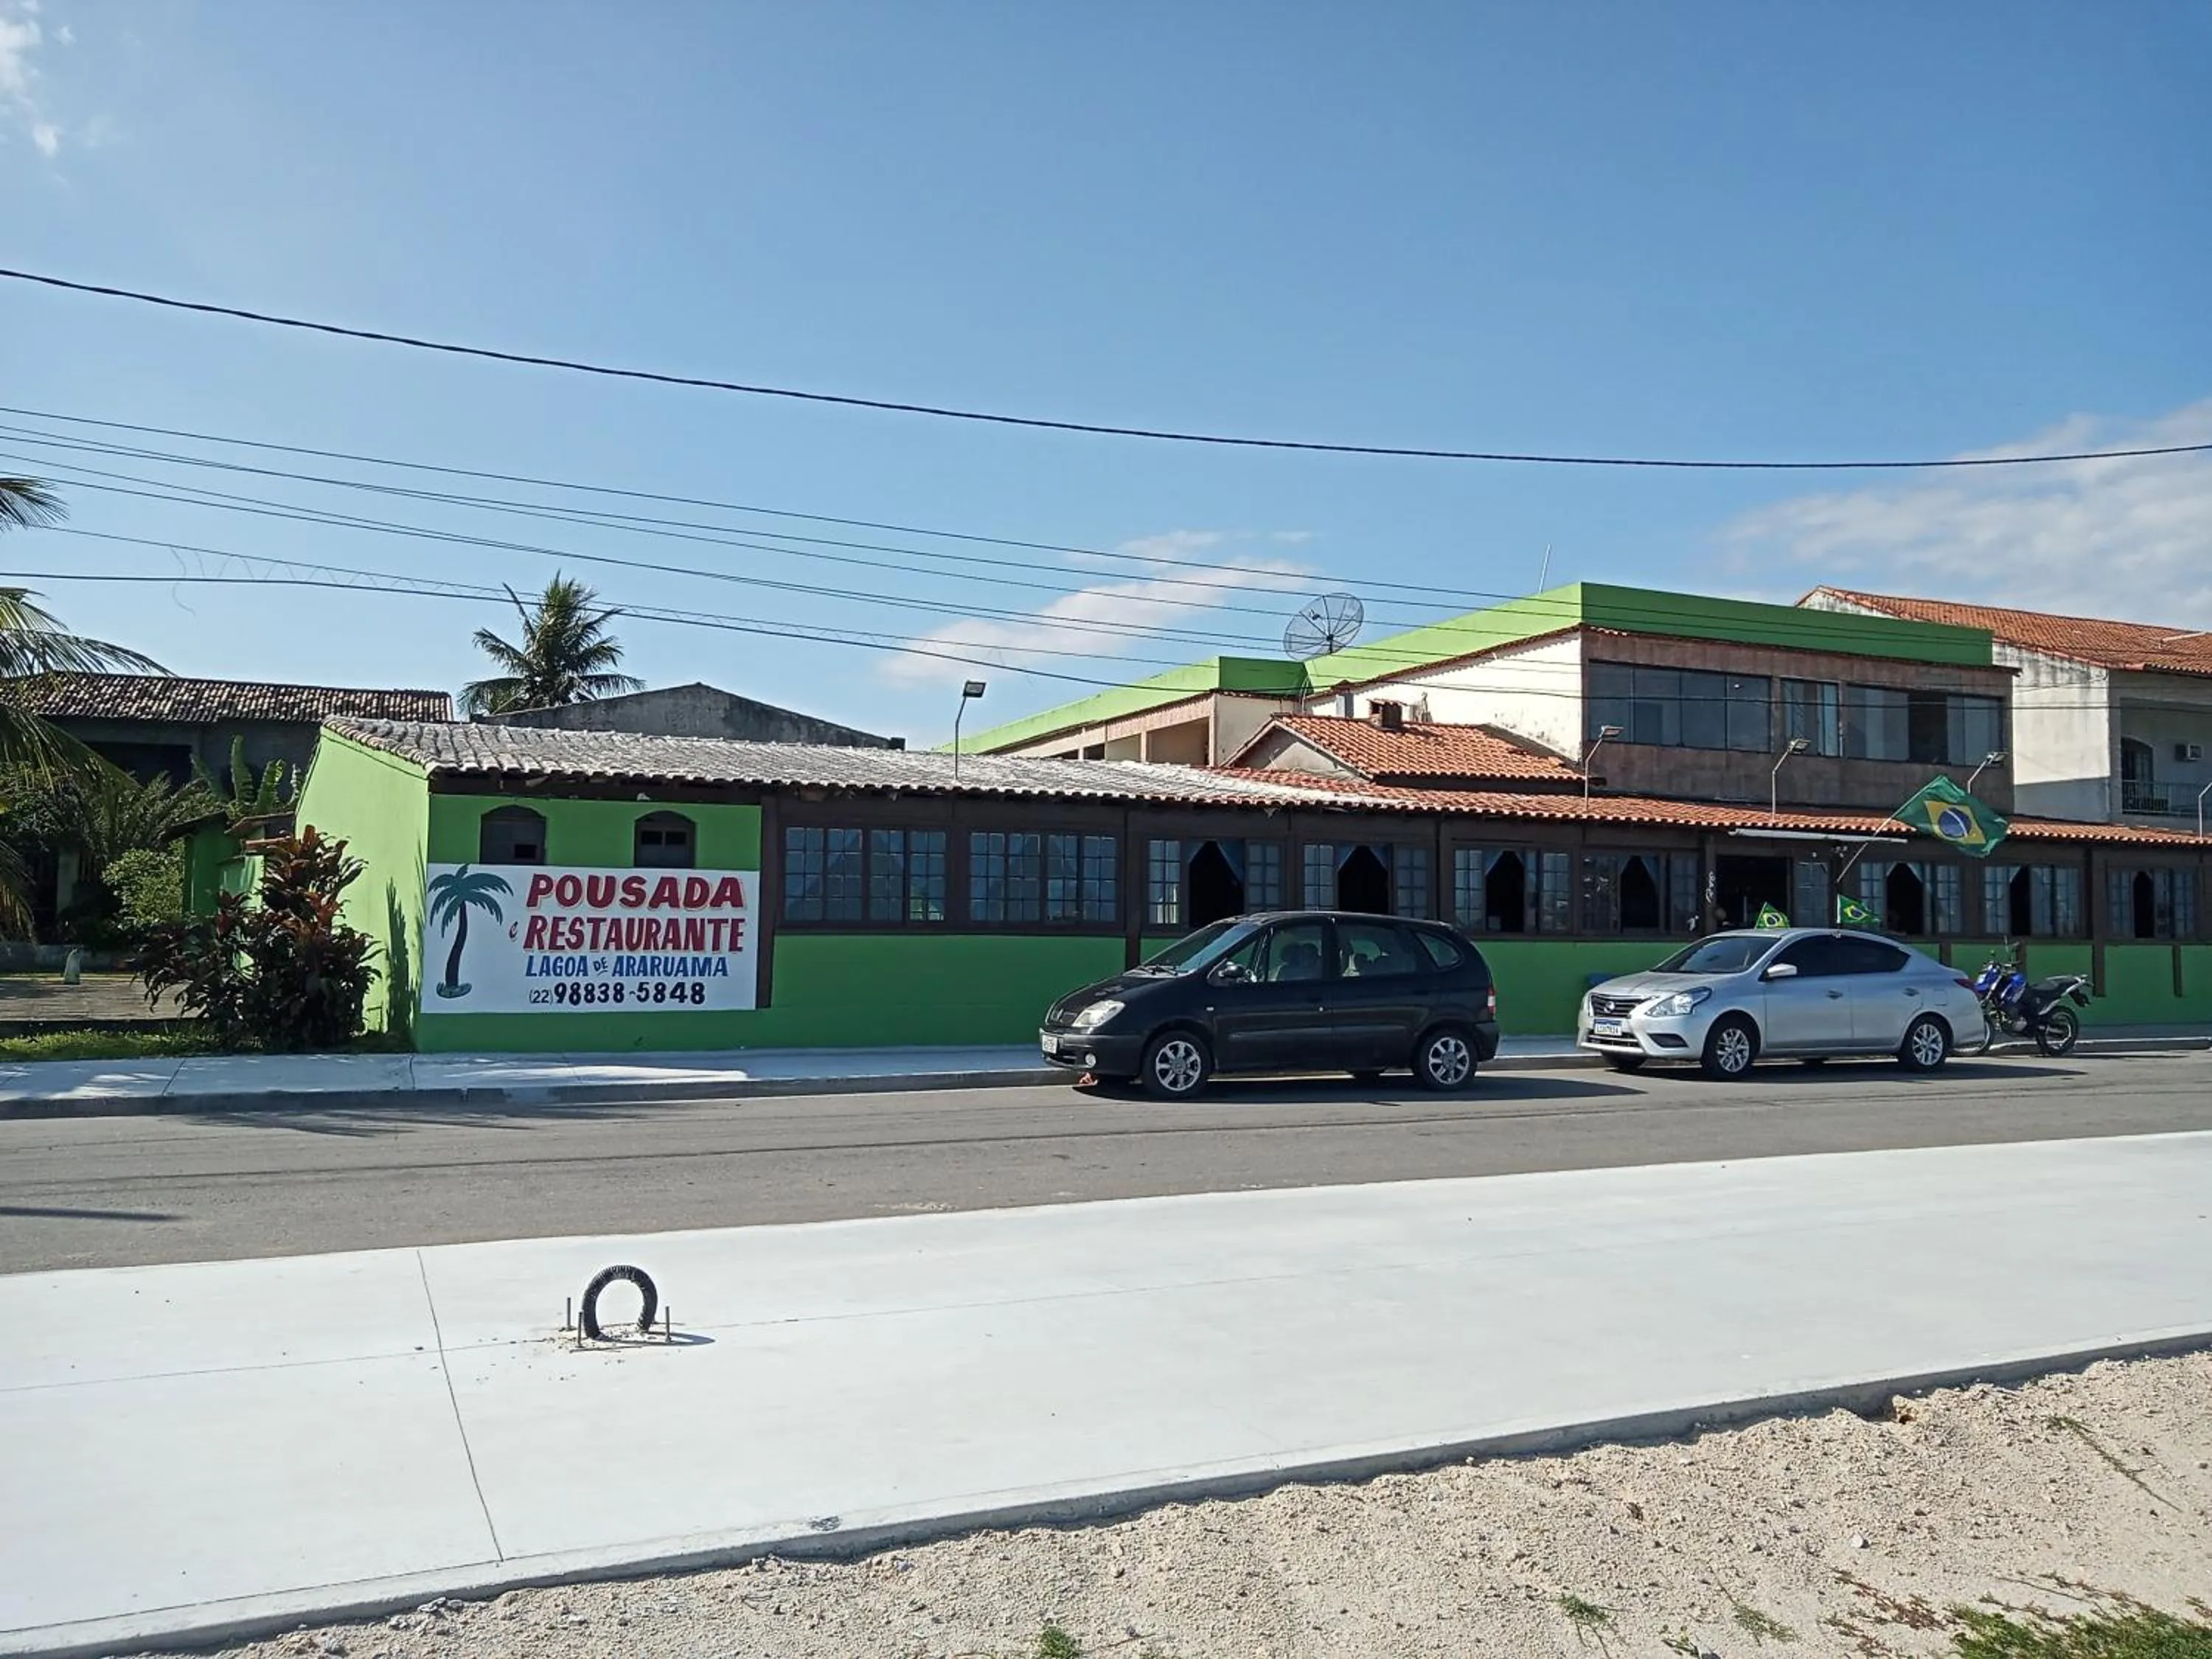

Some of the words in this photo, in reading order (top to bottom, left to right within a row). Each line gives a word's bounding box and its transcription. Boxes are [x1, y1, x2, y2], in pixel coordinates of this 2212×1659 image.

[526, 874, 744, 909] POUSADA
[523, 915, 743, 952] RESTAURANTE
[525, 955, 588, 977] LAGOA
[593, 957, 608, 973] DE
[611, 956, 728, 977] ARARUAMA
